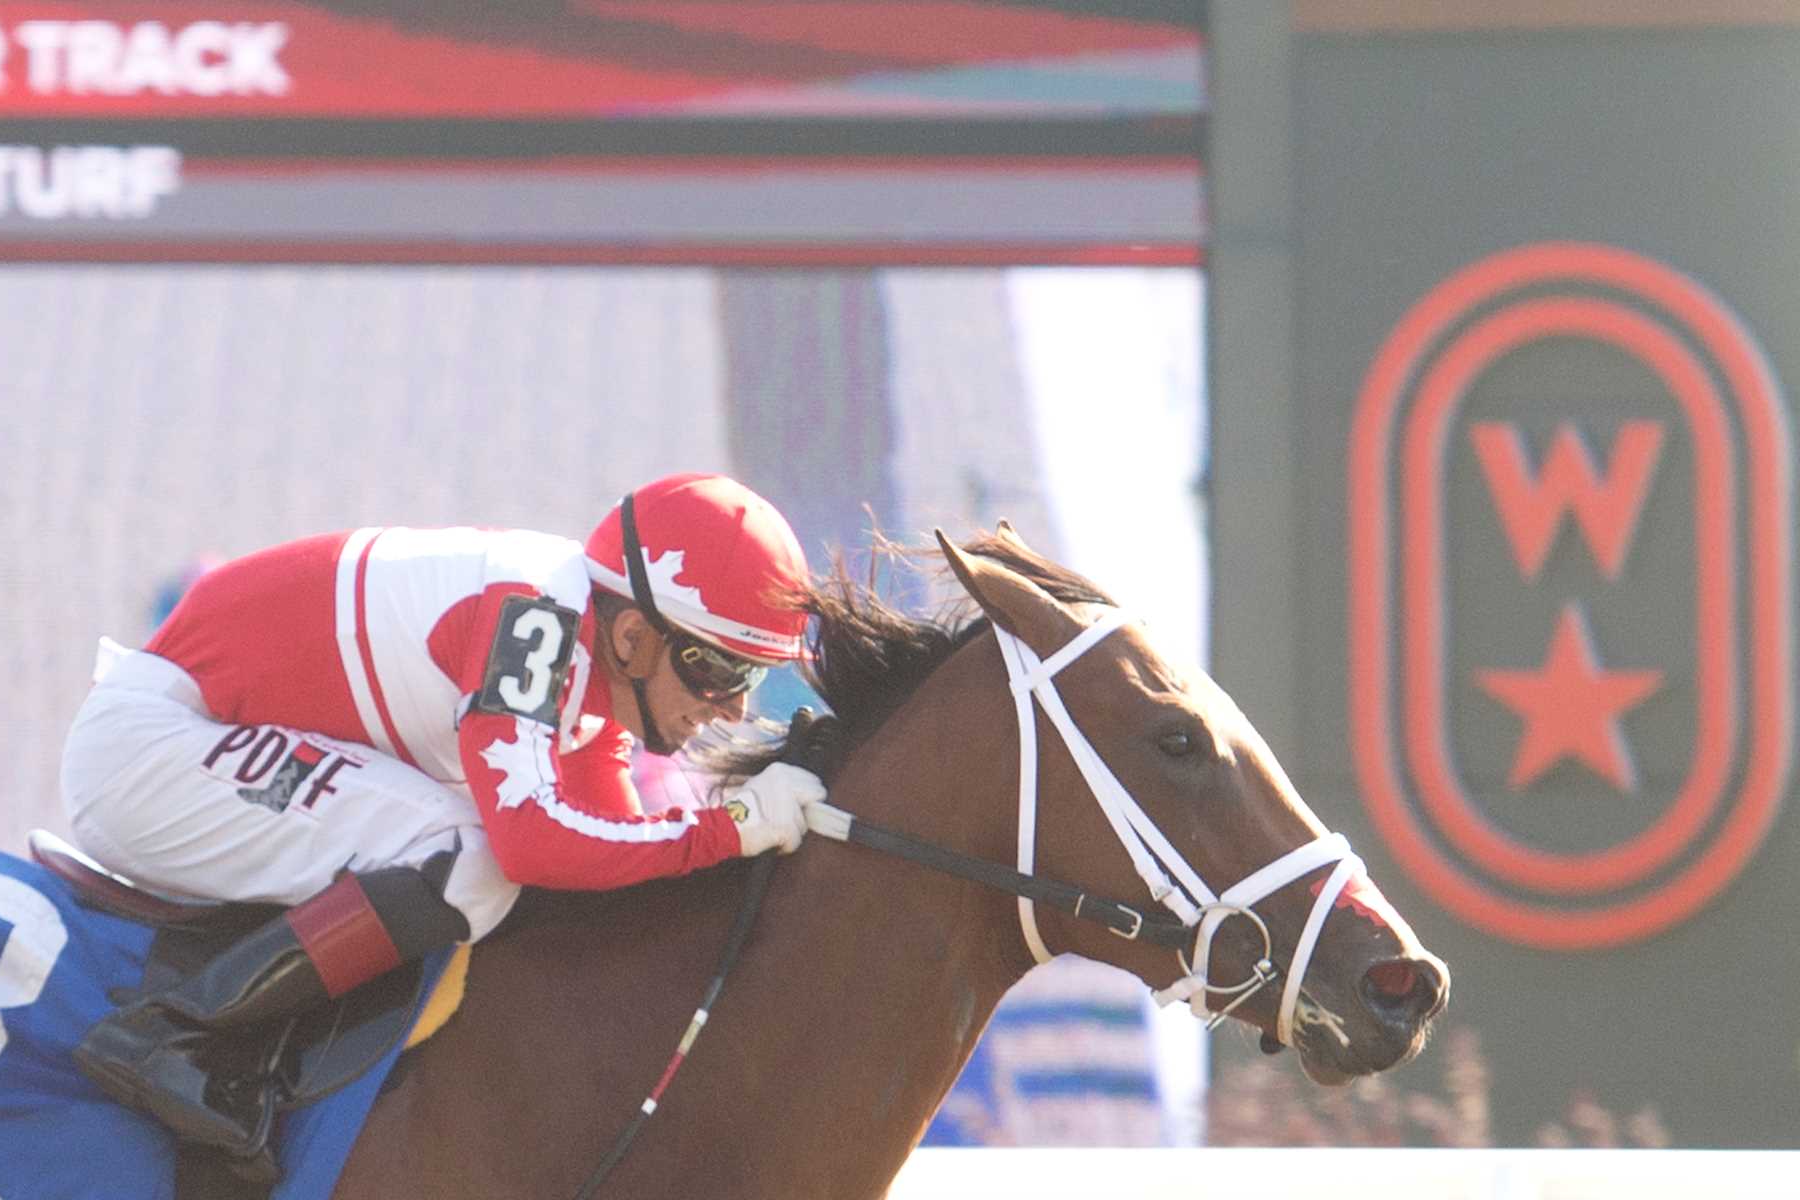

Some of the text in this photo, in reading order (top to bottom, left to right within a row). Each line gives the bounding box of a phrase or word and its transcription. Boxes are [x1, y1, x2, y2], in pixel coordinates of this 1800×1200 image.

[16, 21, 291, 95] TRACK
[1468, 420, 1667, 581] W
[498, 607, 563, 714] 3
